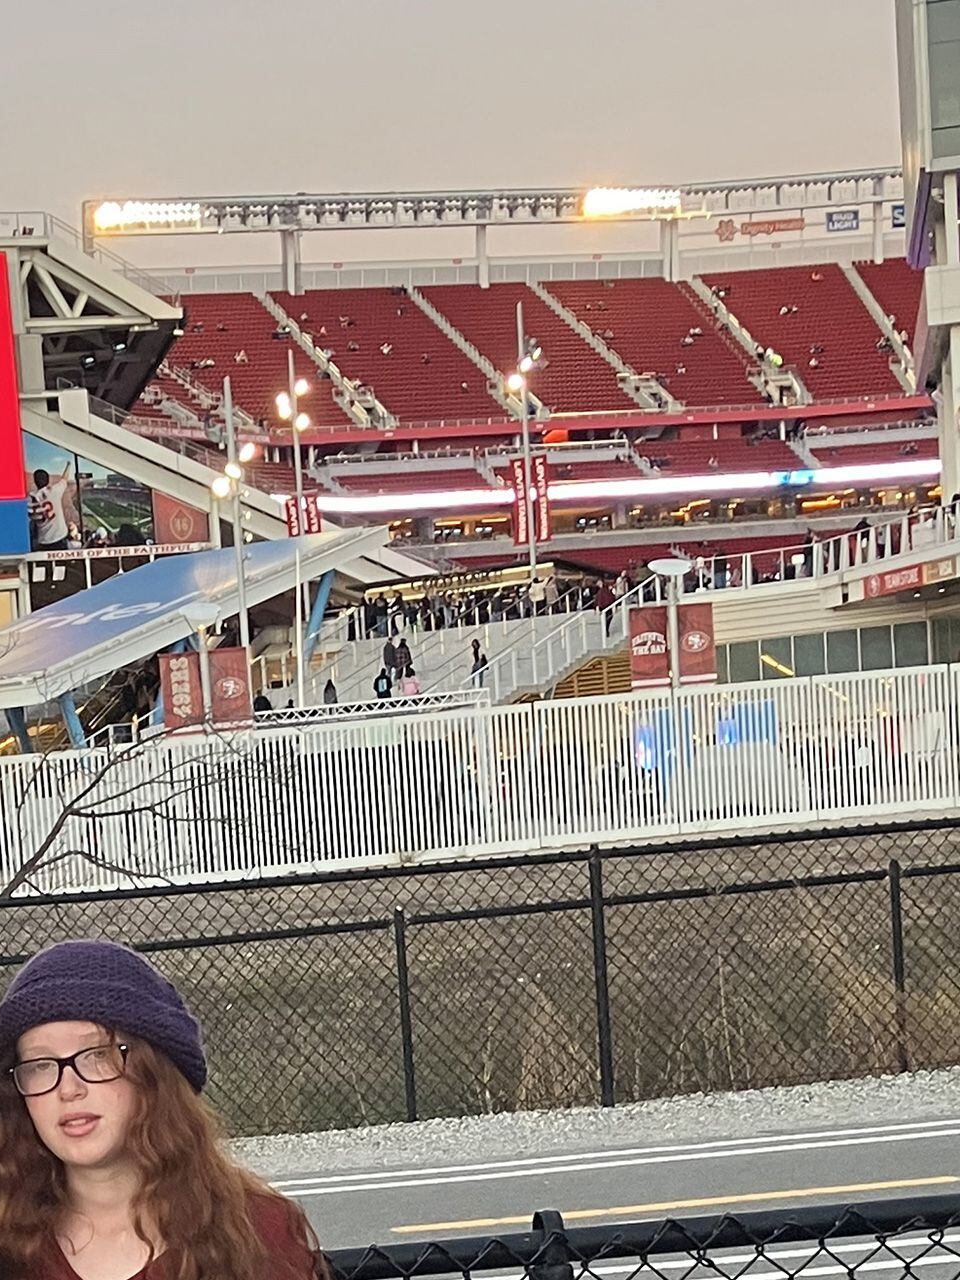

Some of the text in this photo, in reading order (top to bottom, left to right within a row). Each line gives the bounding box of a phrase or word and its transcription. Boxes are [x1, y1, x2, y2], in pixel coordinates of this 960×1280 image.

[47, 544, 194, 560] HOME OF THE FAITHFUL
[169, 656, 193, 718] 49ERS
